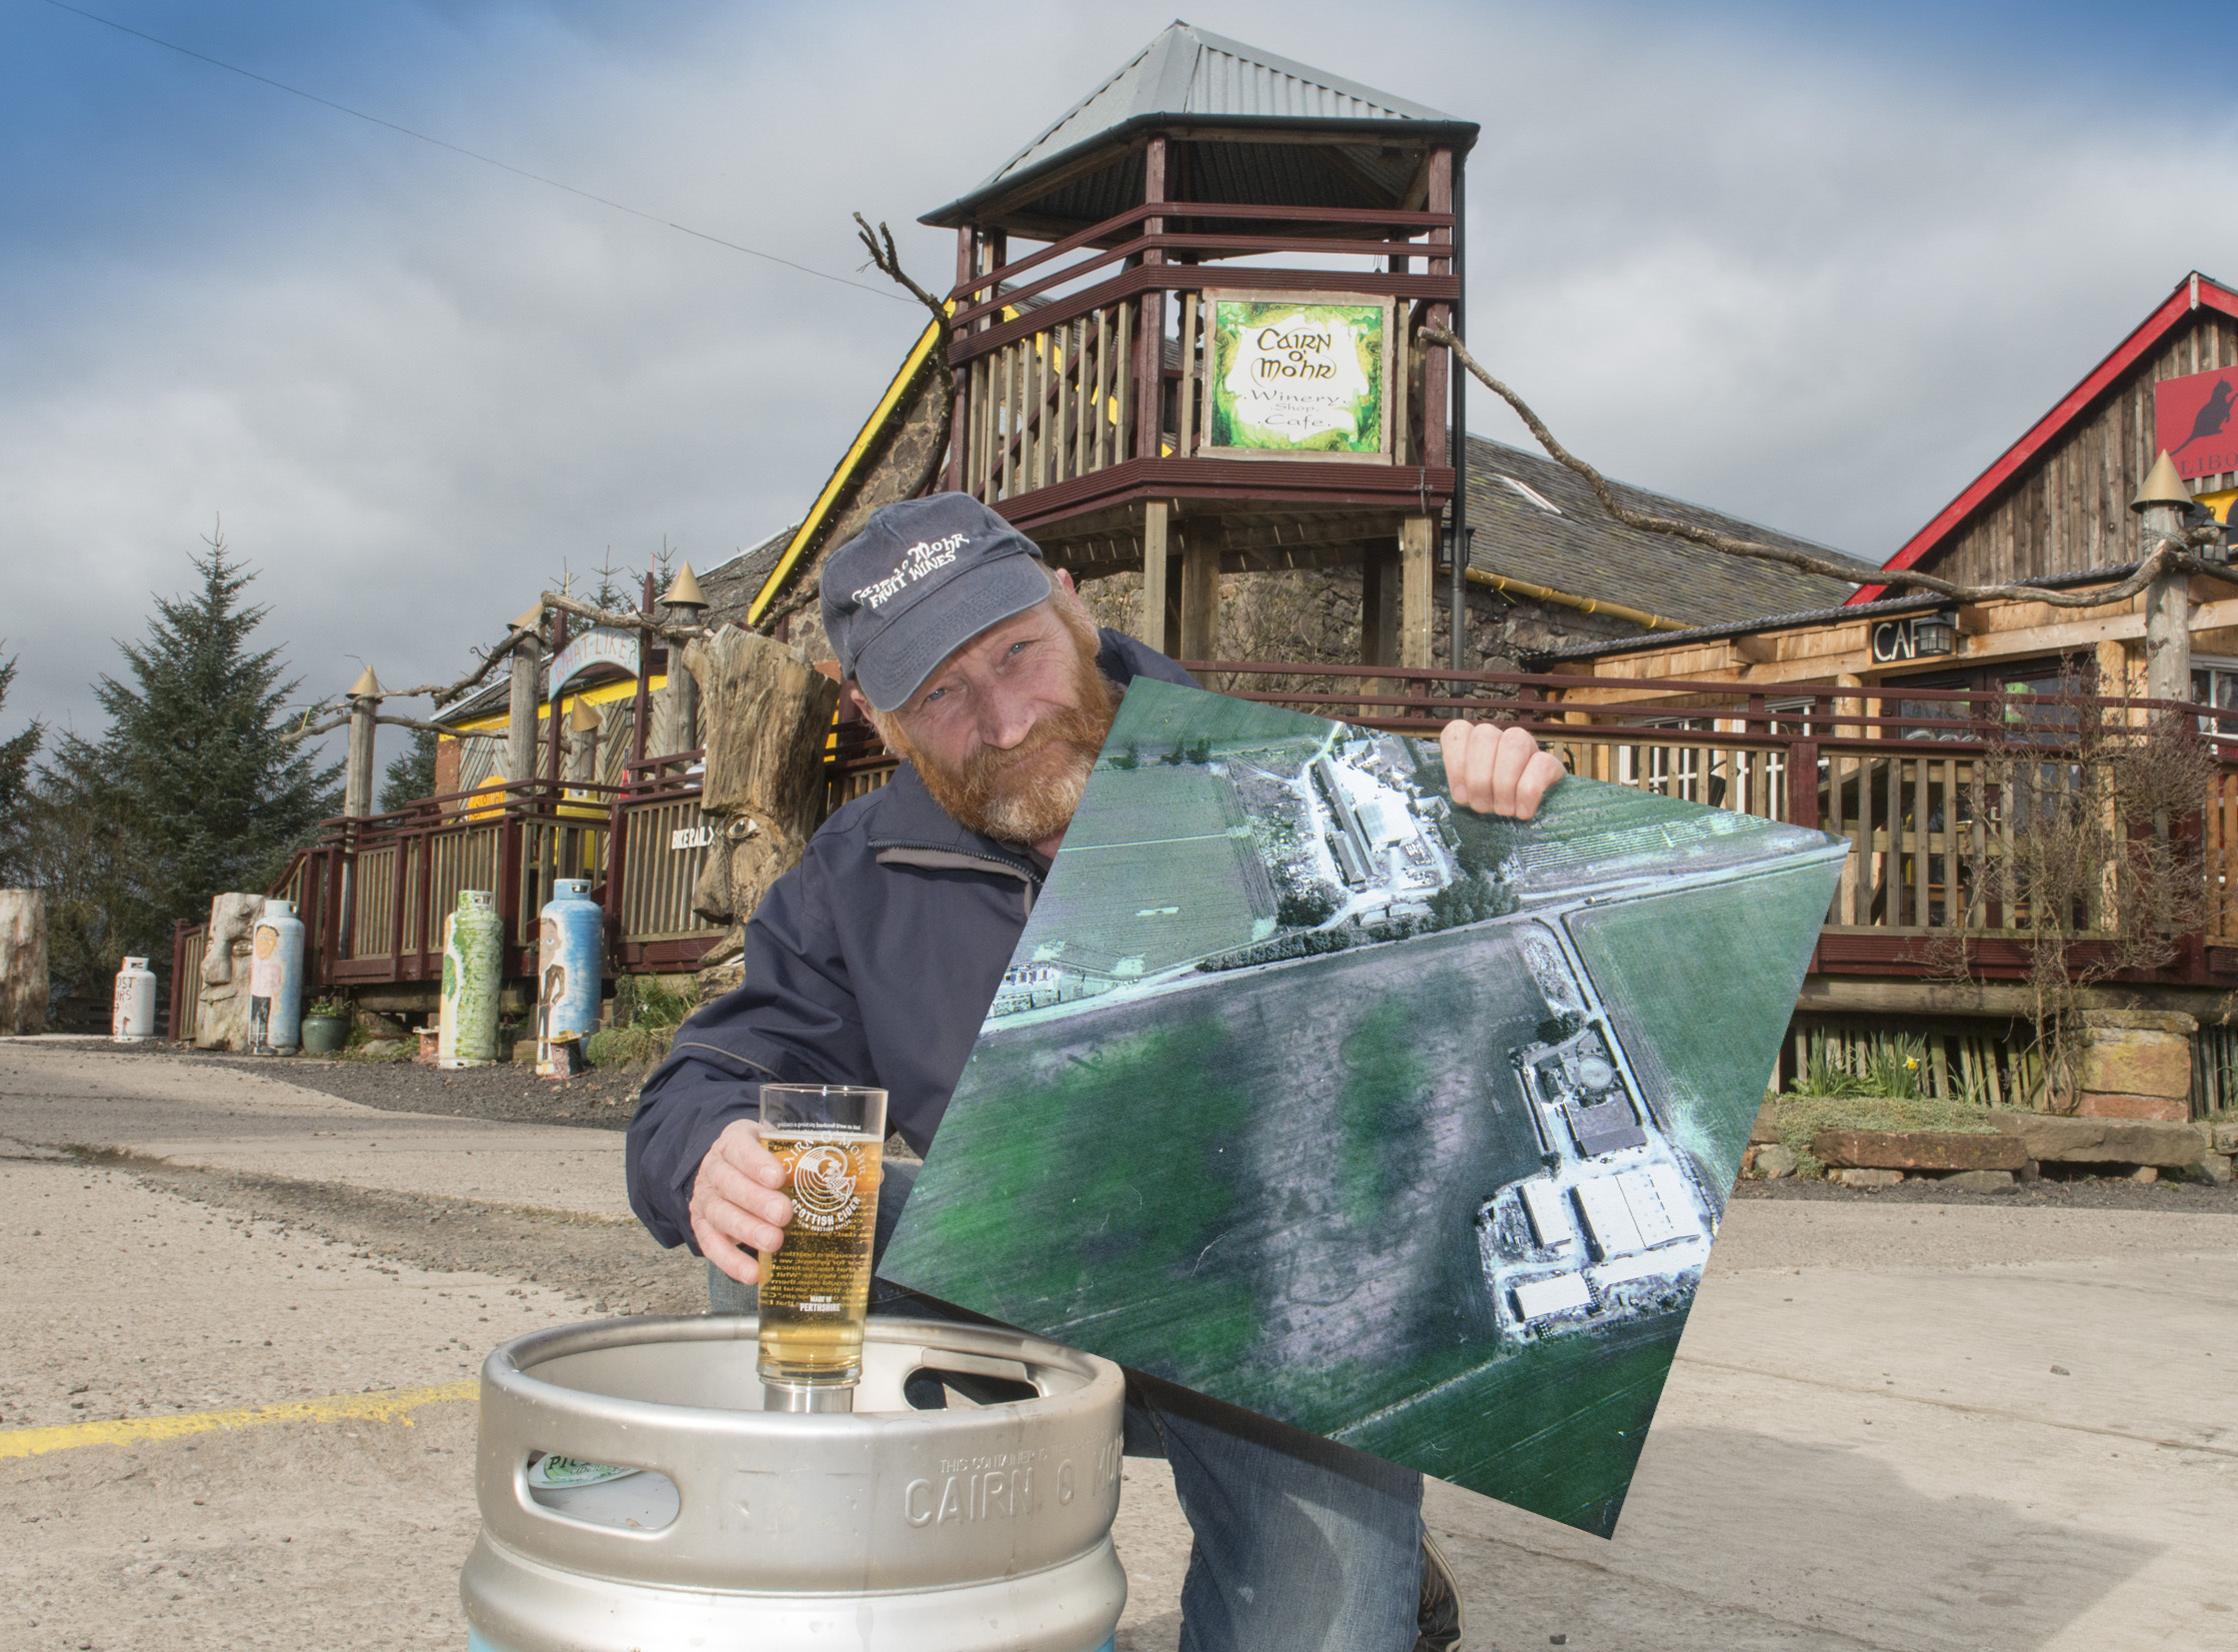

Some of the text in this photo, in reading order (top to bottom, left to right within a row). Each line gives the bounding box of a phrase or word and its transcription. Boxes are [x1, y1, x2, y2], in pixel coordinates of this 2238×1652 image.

[1251, 390, 1339, 406] Winery
[1272, 403, 1315, 413] Shop
[1264, 414, 1324, 430] Cafe
[869, 551, 956, 610] FRUIT WINES
[1873, 616, 1930, 662] CAF
[555, 630, 638, 684] WHAT LIKE?
[672, 826, 707, 849] BIKE RAIL
[792, 1198, 835, 1226] SCOTTISH
[838, 1196, 861, 1222] CIDER
[800, 1303, 842, 1312] PERTHSHIRE
[940, 1458, 969, 1474] THIS
[904, 1466, 1036, 1530] CAIRN
